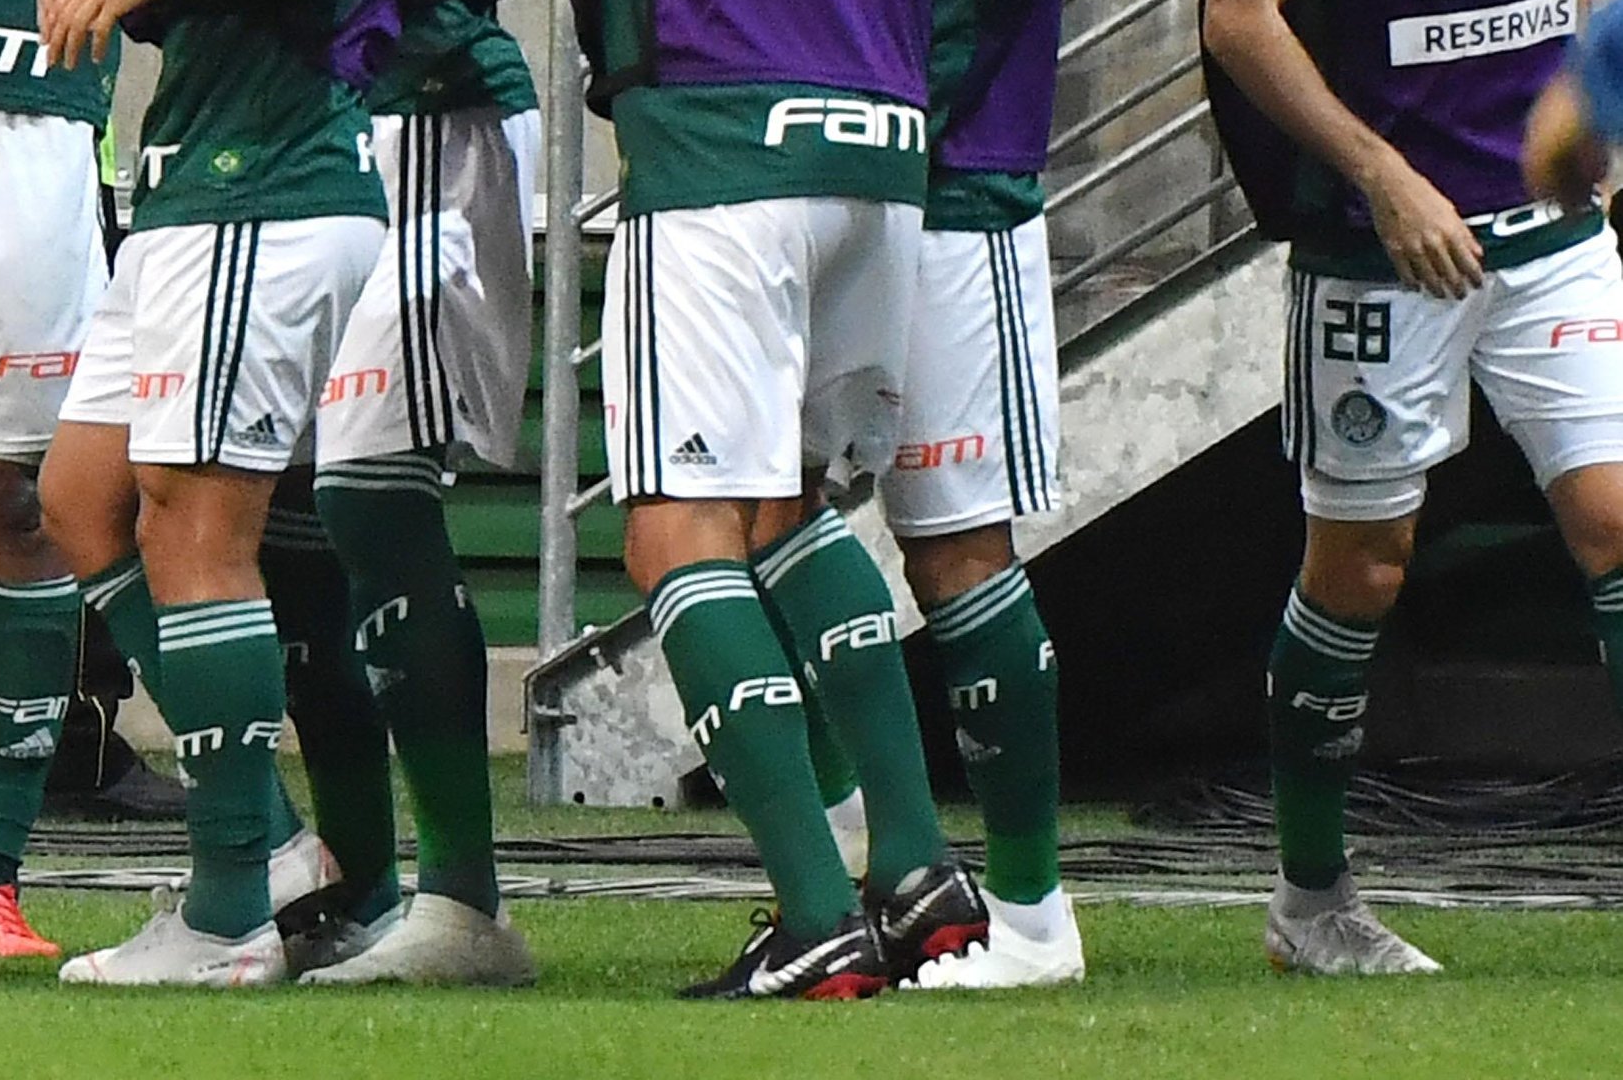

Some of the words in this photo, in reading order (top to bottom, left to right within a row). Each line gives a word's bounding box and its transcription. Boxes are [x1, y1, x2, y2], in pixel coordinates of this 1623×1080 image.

[1323, 299, 1392, 363] 28
[1549, 317, 1623, 349] Fa
[895, 434, 985, 471] am
[729, 676, 803, 712] Fa
